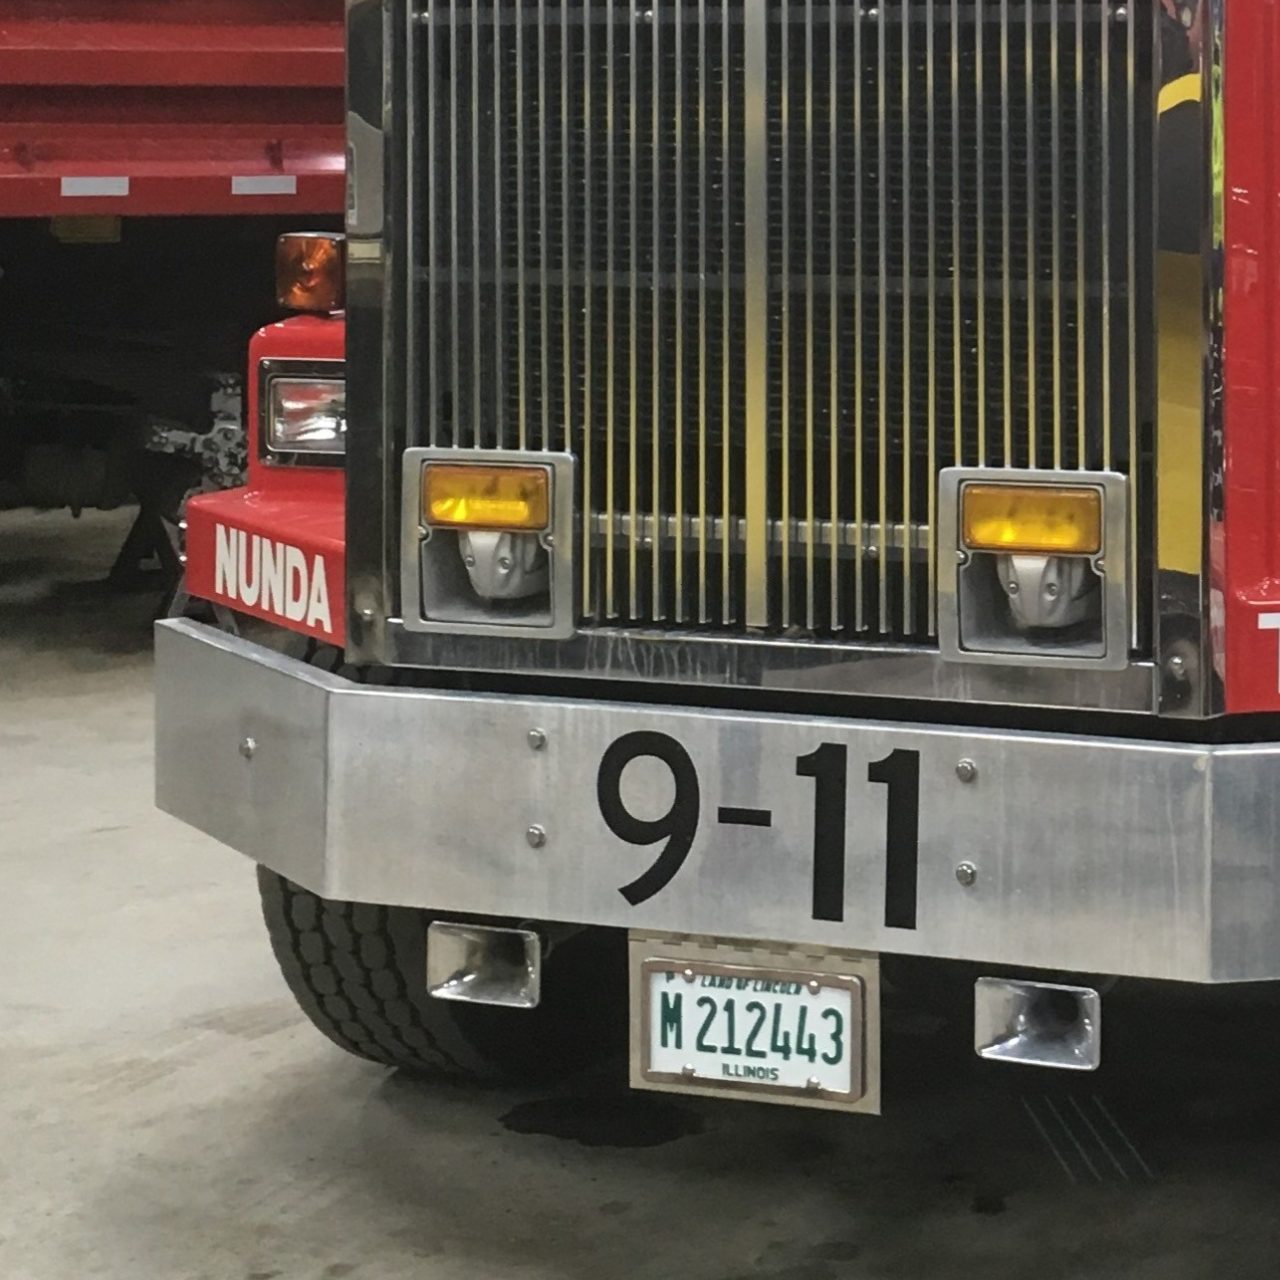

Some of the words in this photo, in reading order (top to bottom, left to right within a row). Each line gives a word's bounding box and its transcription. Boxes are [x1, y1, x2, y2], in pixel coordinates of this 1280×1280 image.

[215, 523, 333, 634] NUNDA
[597, 729, 920, 931] 9-11
[660, 991, 683, 1050] M
[695, 996, 844, 1065] 212443
[721, 1062, 780, 1082] ILLINOIS
